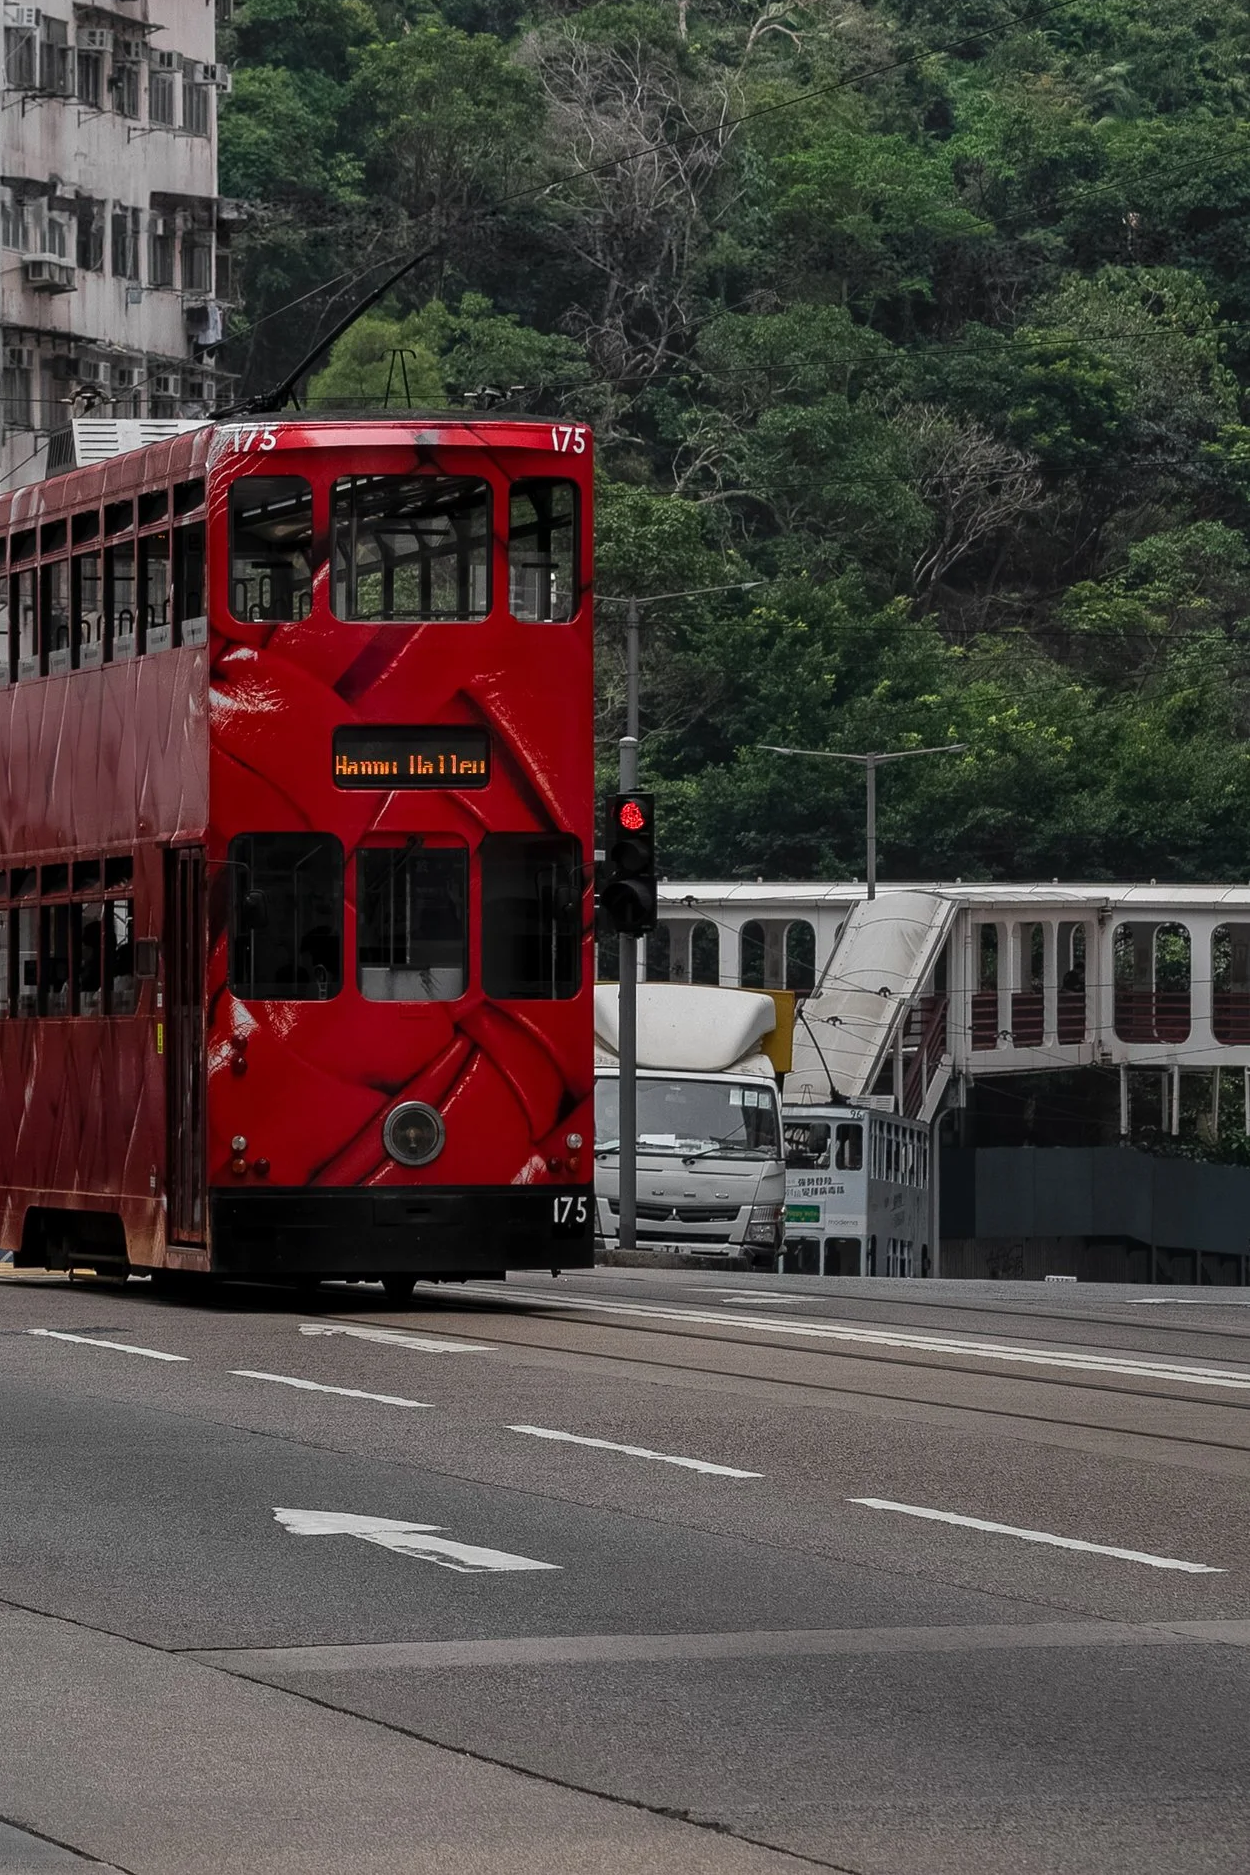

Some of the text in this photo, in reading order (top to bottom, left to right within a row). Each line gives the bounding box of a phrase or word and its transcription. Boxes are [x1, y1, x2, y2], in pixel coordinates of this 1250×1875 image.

[234, 425, 278, 452] 175
[551, 426, 586, 454] 175
[553, 1196, 587, 1223] 175
